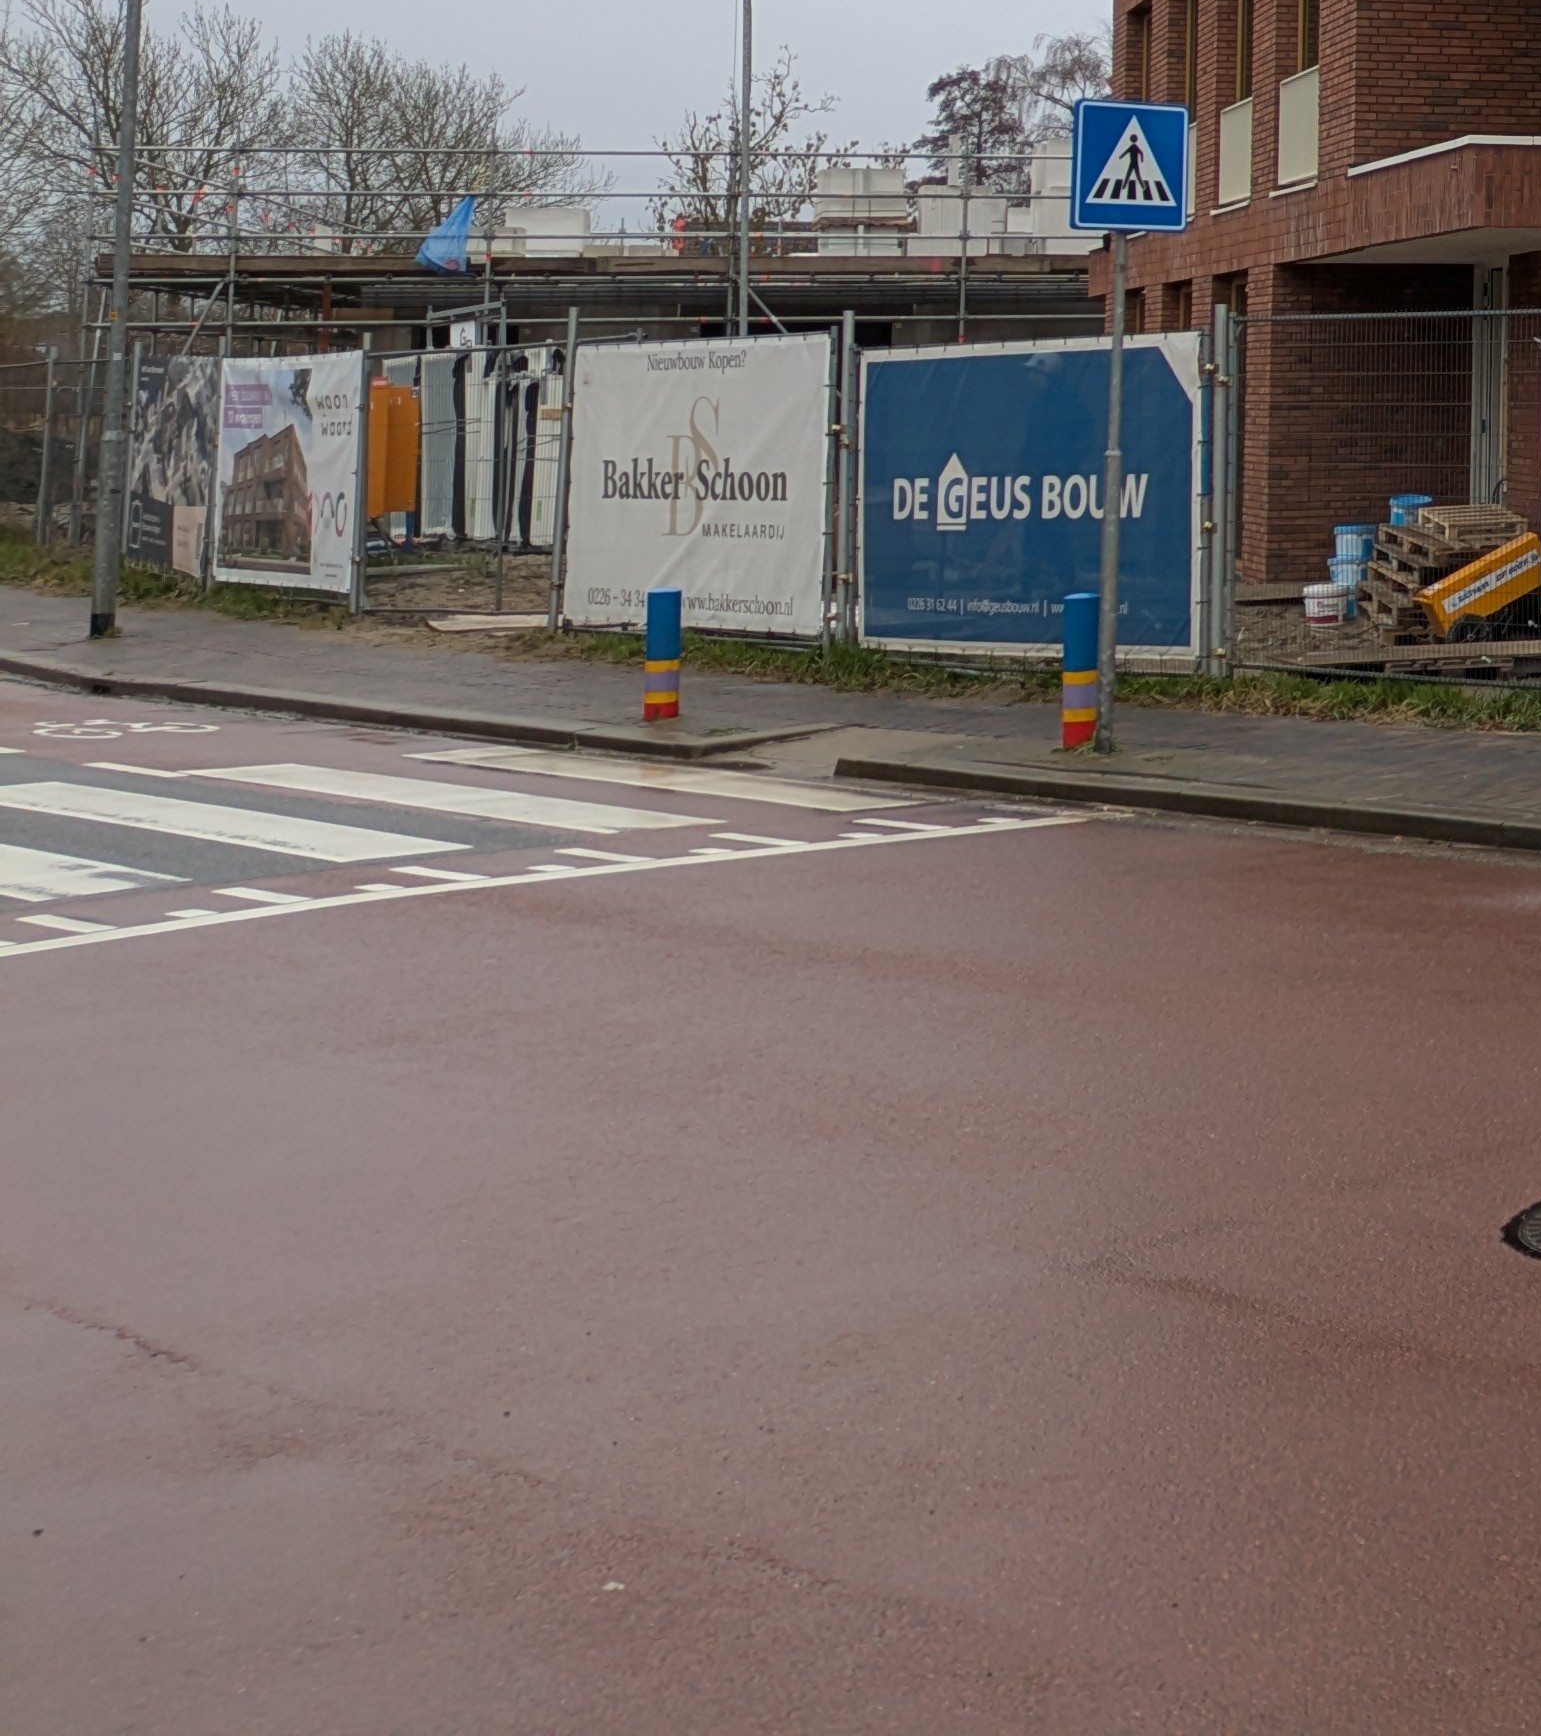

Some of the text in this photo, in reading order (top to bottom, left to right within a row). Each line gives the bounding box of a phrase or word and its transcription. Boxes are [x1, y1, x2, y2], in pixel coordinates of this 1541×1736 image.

[647, 349, 747, 375] Nieuwbouw Kopen?
[602, 456, 789, 502] Bakker Schoon
[893, 473, 1150, 521] DE GEUS BOUW
[702, 523, 786, 540] MAKELAARDIJ
[588, 586, 611, 606] 0226
[620, 588, 633, 607] 34
[633, 589, 646, 608] 34
